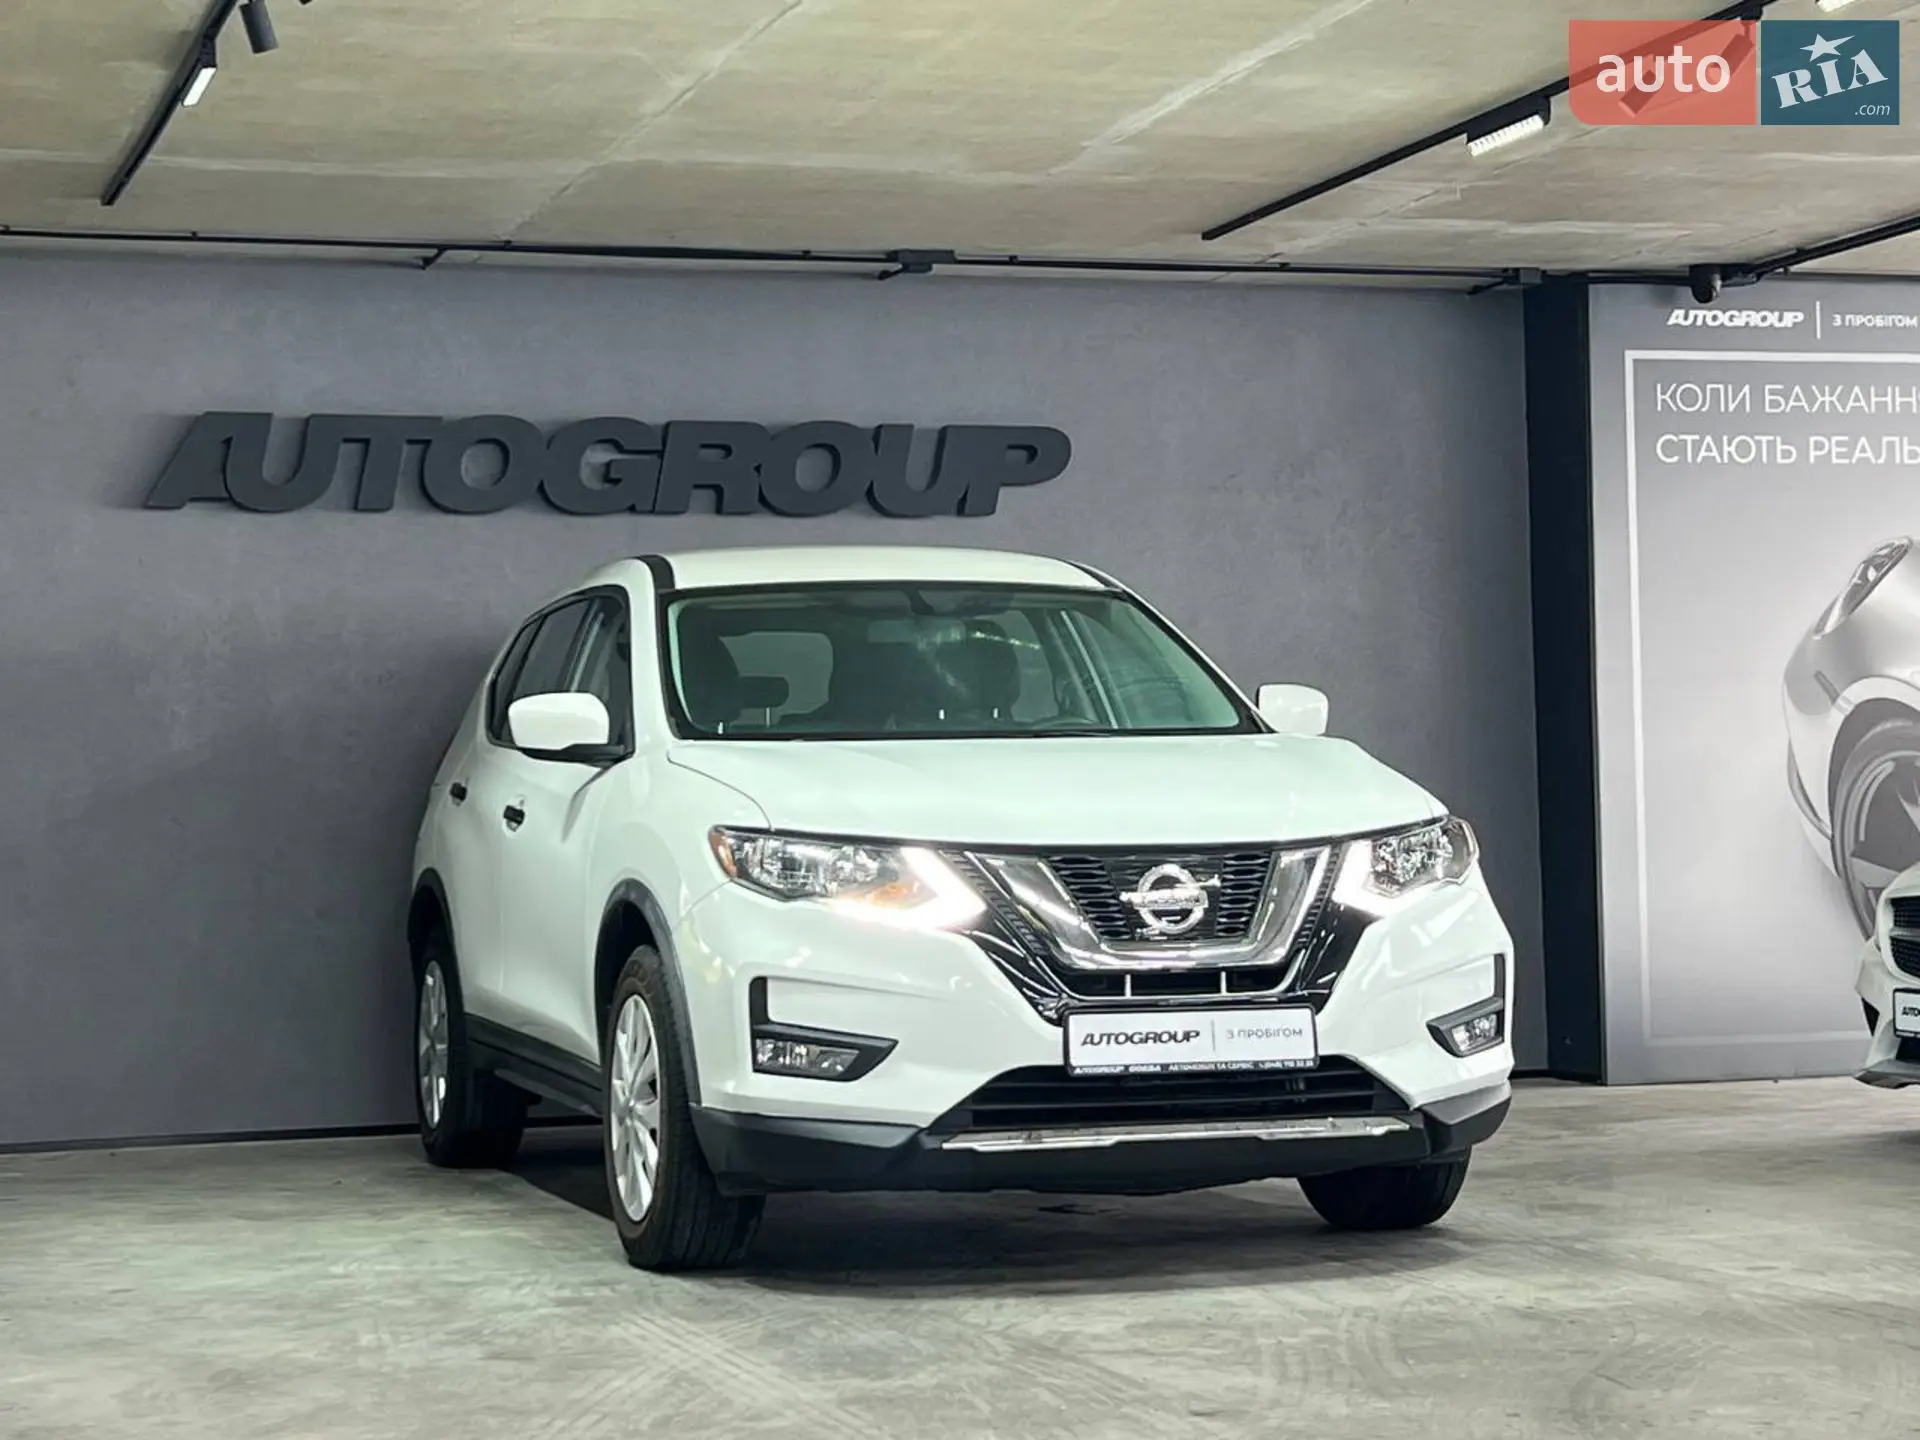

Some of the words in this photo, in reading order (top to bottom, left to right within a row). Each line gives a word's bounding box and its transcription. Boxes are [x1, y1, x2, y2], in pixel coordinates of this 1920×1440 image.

[1667, 308, 1804, 328] AUTOGROUP
[1845, 314, 1918, 328] ПРОБІГОМ
[1656, 383, 1750, 412] КОЛИ
[1764, 385, 1920, 413] БАЖАНН
[1655, 434, 1797, 464] СТАЮТЬ
[144, 411, 1072, 518] AUTOGROUP
[1081, 1029, 1201, 1047] AUTOGROUP
[1238, 1027, 1303, 1039] ПРОБІГОМ
